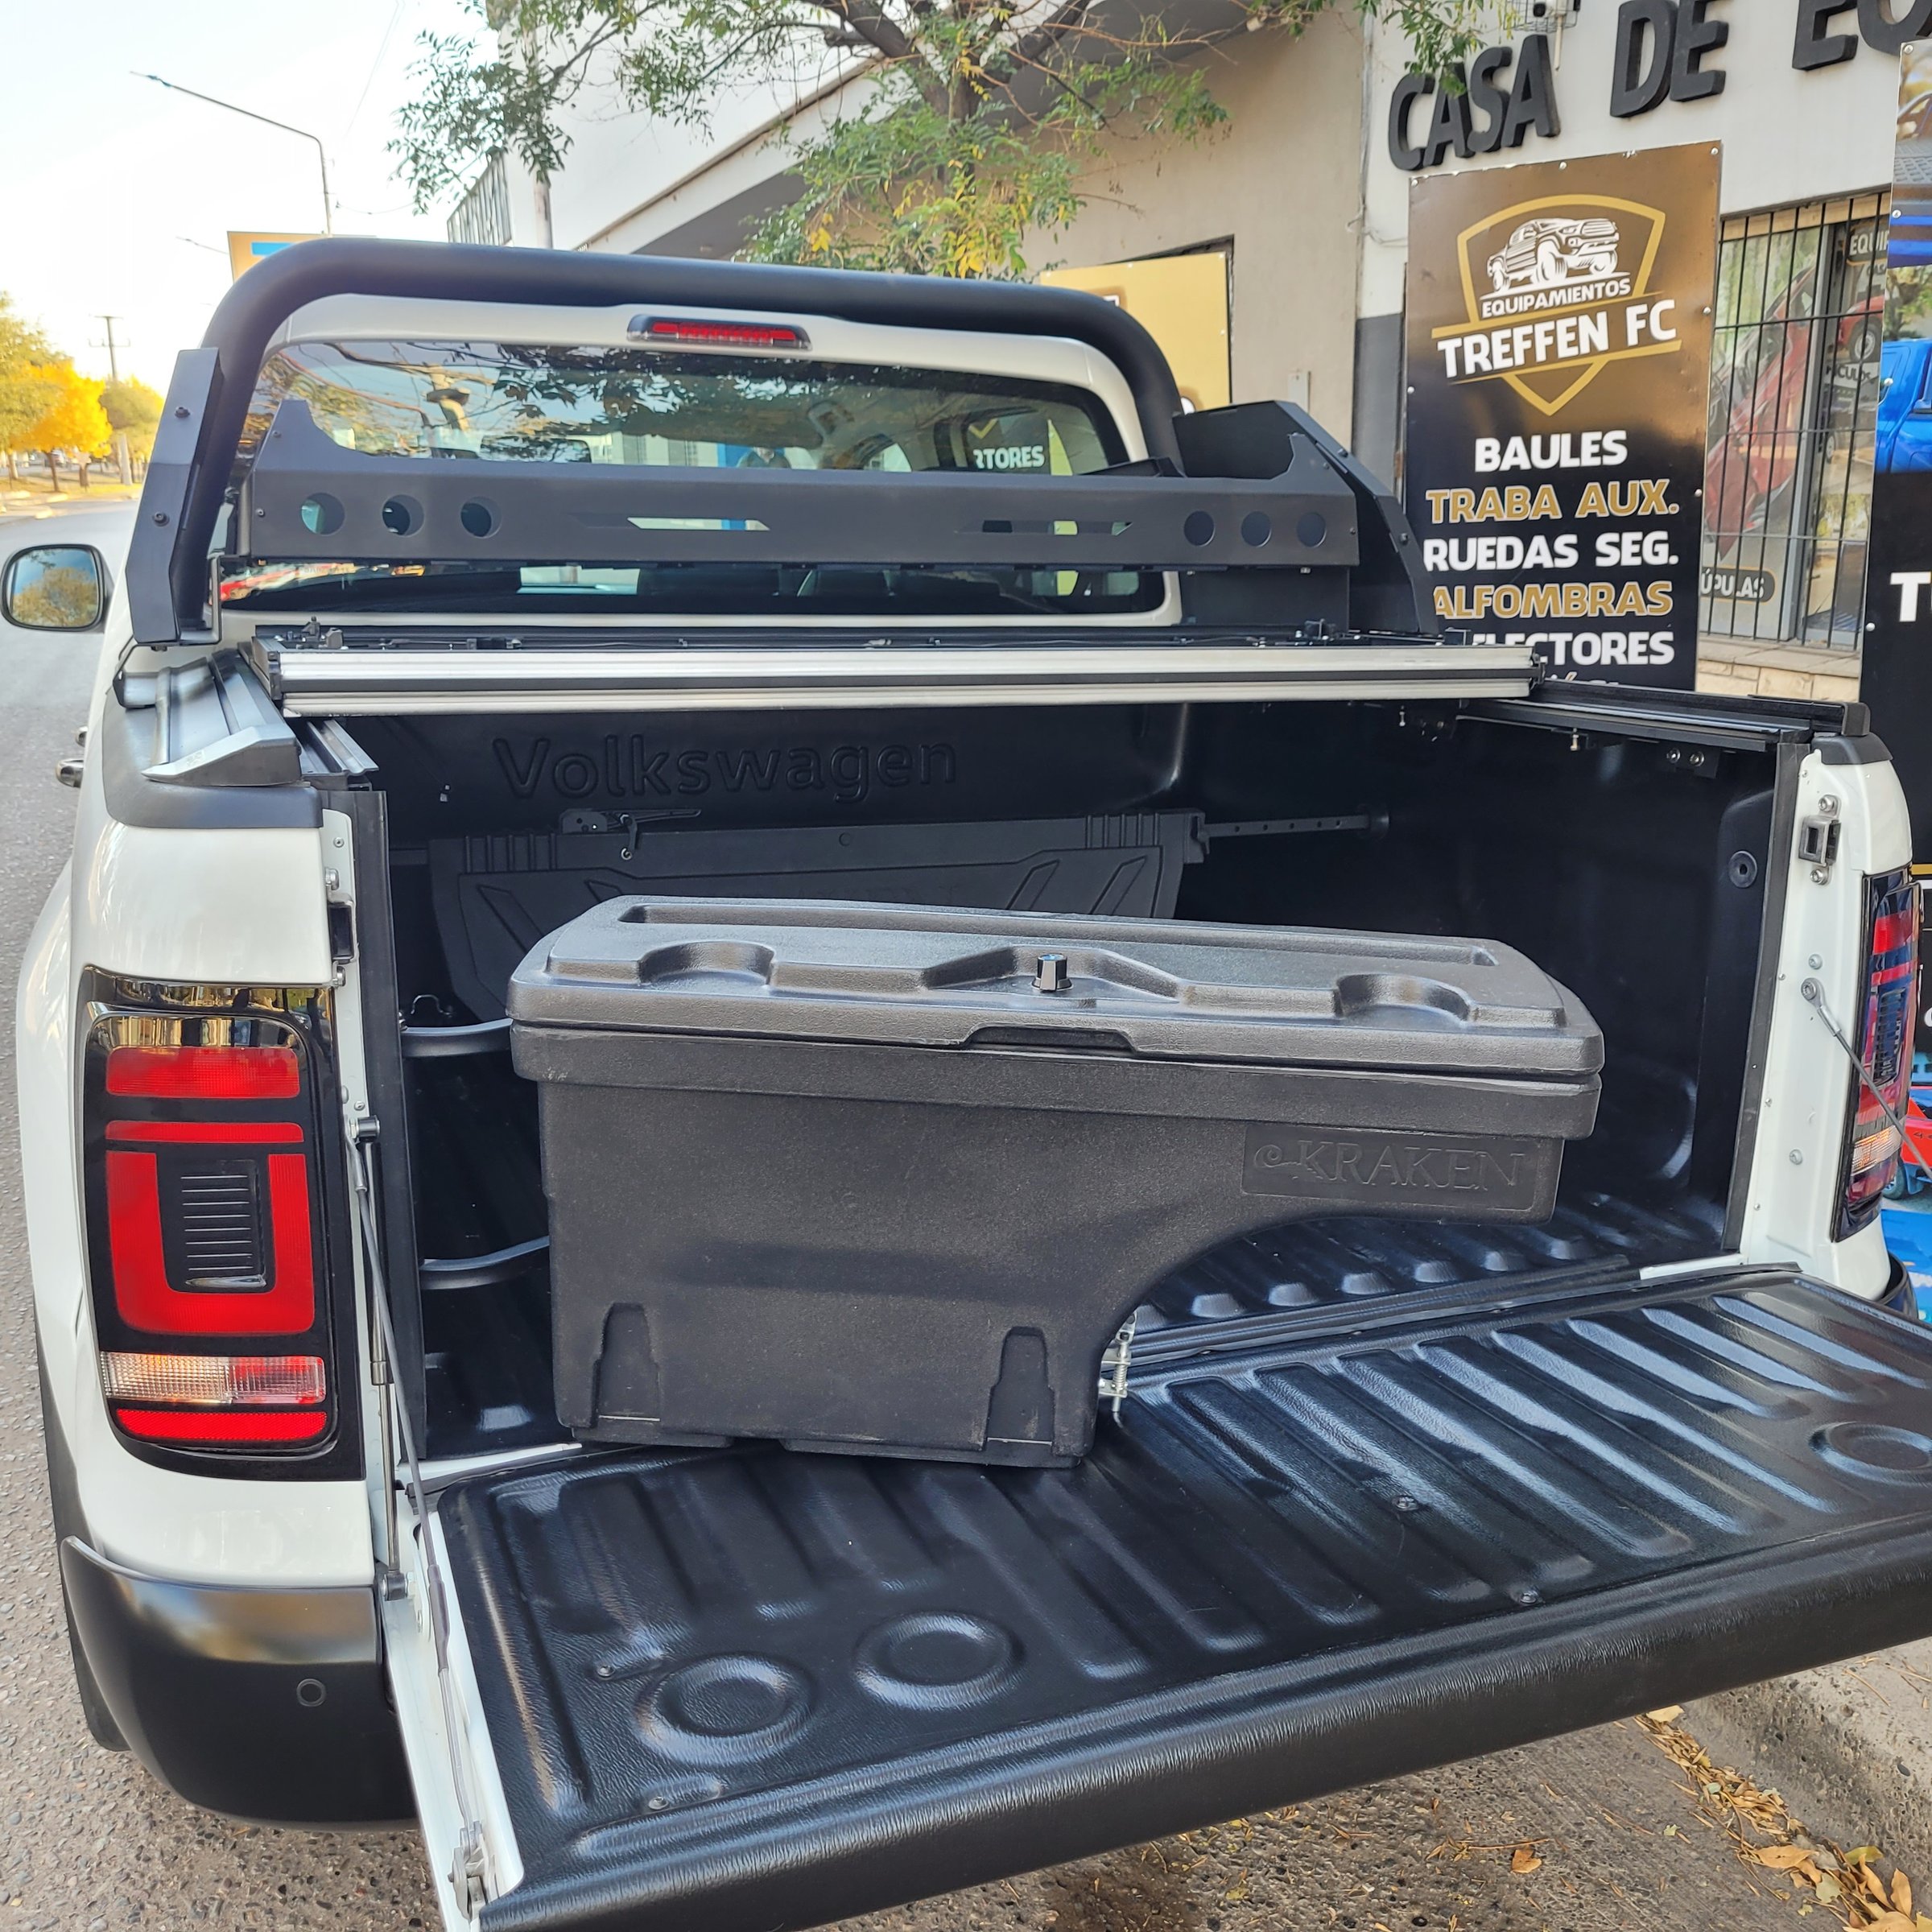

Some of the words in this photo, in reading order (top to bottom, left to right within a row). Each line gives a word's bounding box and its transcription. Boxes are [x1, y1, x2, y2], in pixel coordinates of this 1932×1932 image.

[1389, 35, 1560, 171] CASA
[1610, 0, 1729, 118] DE
[1481, 278, 1631, 318] EQUIPAMIENTOS
[1437, 311, 1609, 378] TREFFEN
[1625, 299, 1677, 347] FC
[1475, 430, 1628, 473] BAULES
[1426, 484, 1563, 524] TRABA
[1575, 478, 1680, 518] AUX.
[1423, 534, 1579, 572] RUEDAS
[1596, 530, 1679, 567] SEG.
[1433, 580, 1674, 619] ALFOMBRAS
[492, 733, 958, 803] Volkswagen
[1293, 1140, 1526, 1191] KRAKEN
